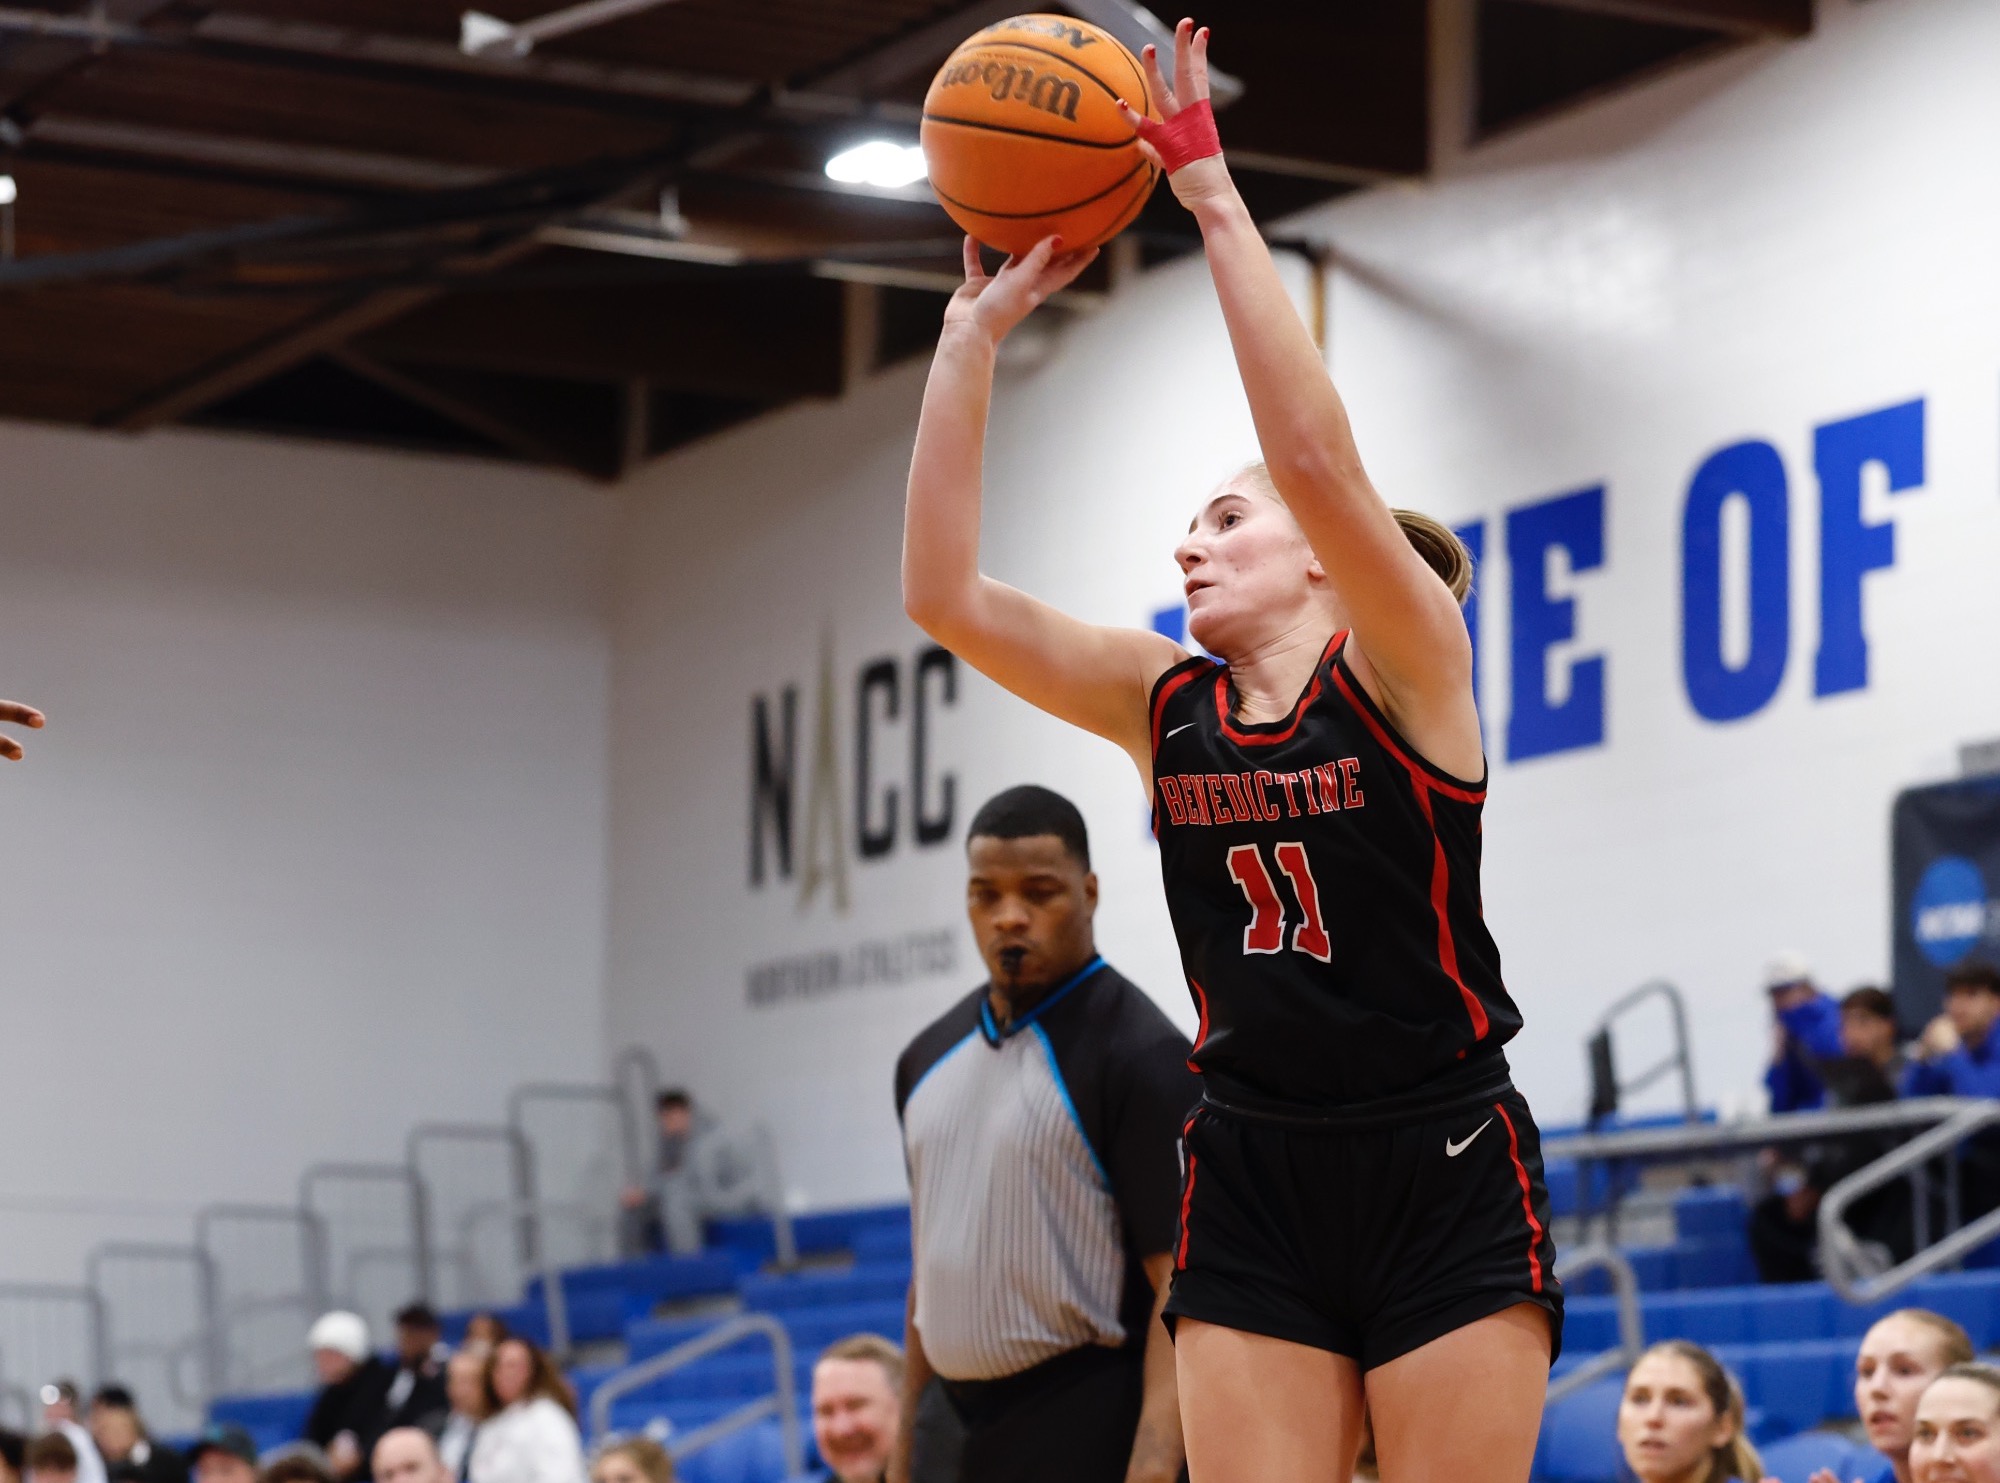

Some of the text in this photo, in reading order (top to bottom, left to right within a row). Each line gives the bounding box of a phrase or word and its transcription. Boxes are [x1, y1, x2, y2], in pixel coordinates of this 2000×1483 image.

[941, 61, 1082, 122] Wilson
[1681, 396, 1925, 724] OF
[748, 612, 958, 918] NACC
[1158, 757, 1365, 826] BENEDICTINE
[1226, 841, 1332, 963] 11
